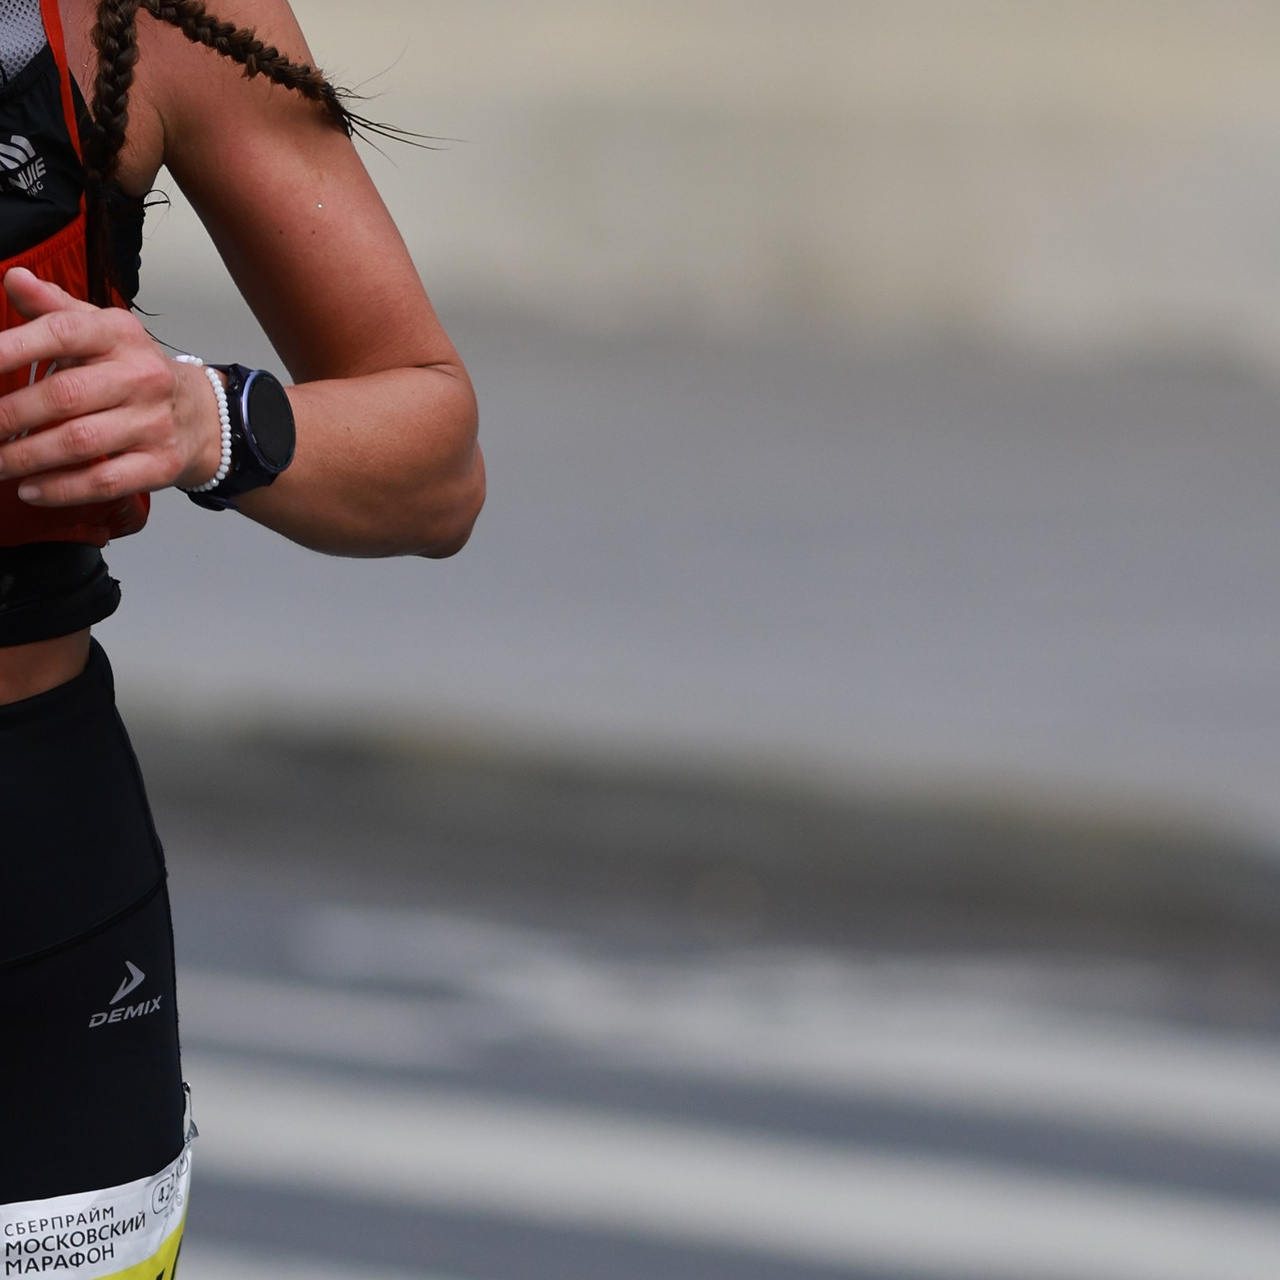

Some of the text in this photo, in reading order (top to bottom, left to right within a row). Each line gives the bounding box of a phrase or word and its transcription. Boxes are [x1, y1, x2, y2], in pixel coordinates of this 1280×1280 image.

[88, 995, 162, 1028] DEMIX
[4, 1206, 115, 1238] СБЕРПРАЙМ
[5, 1211, 146, 1256] МОСКОВСКИЙ
[5, 1244, 115, 1276] МАРАФОН
